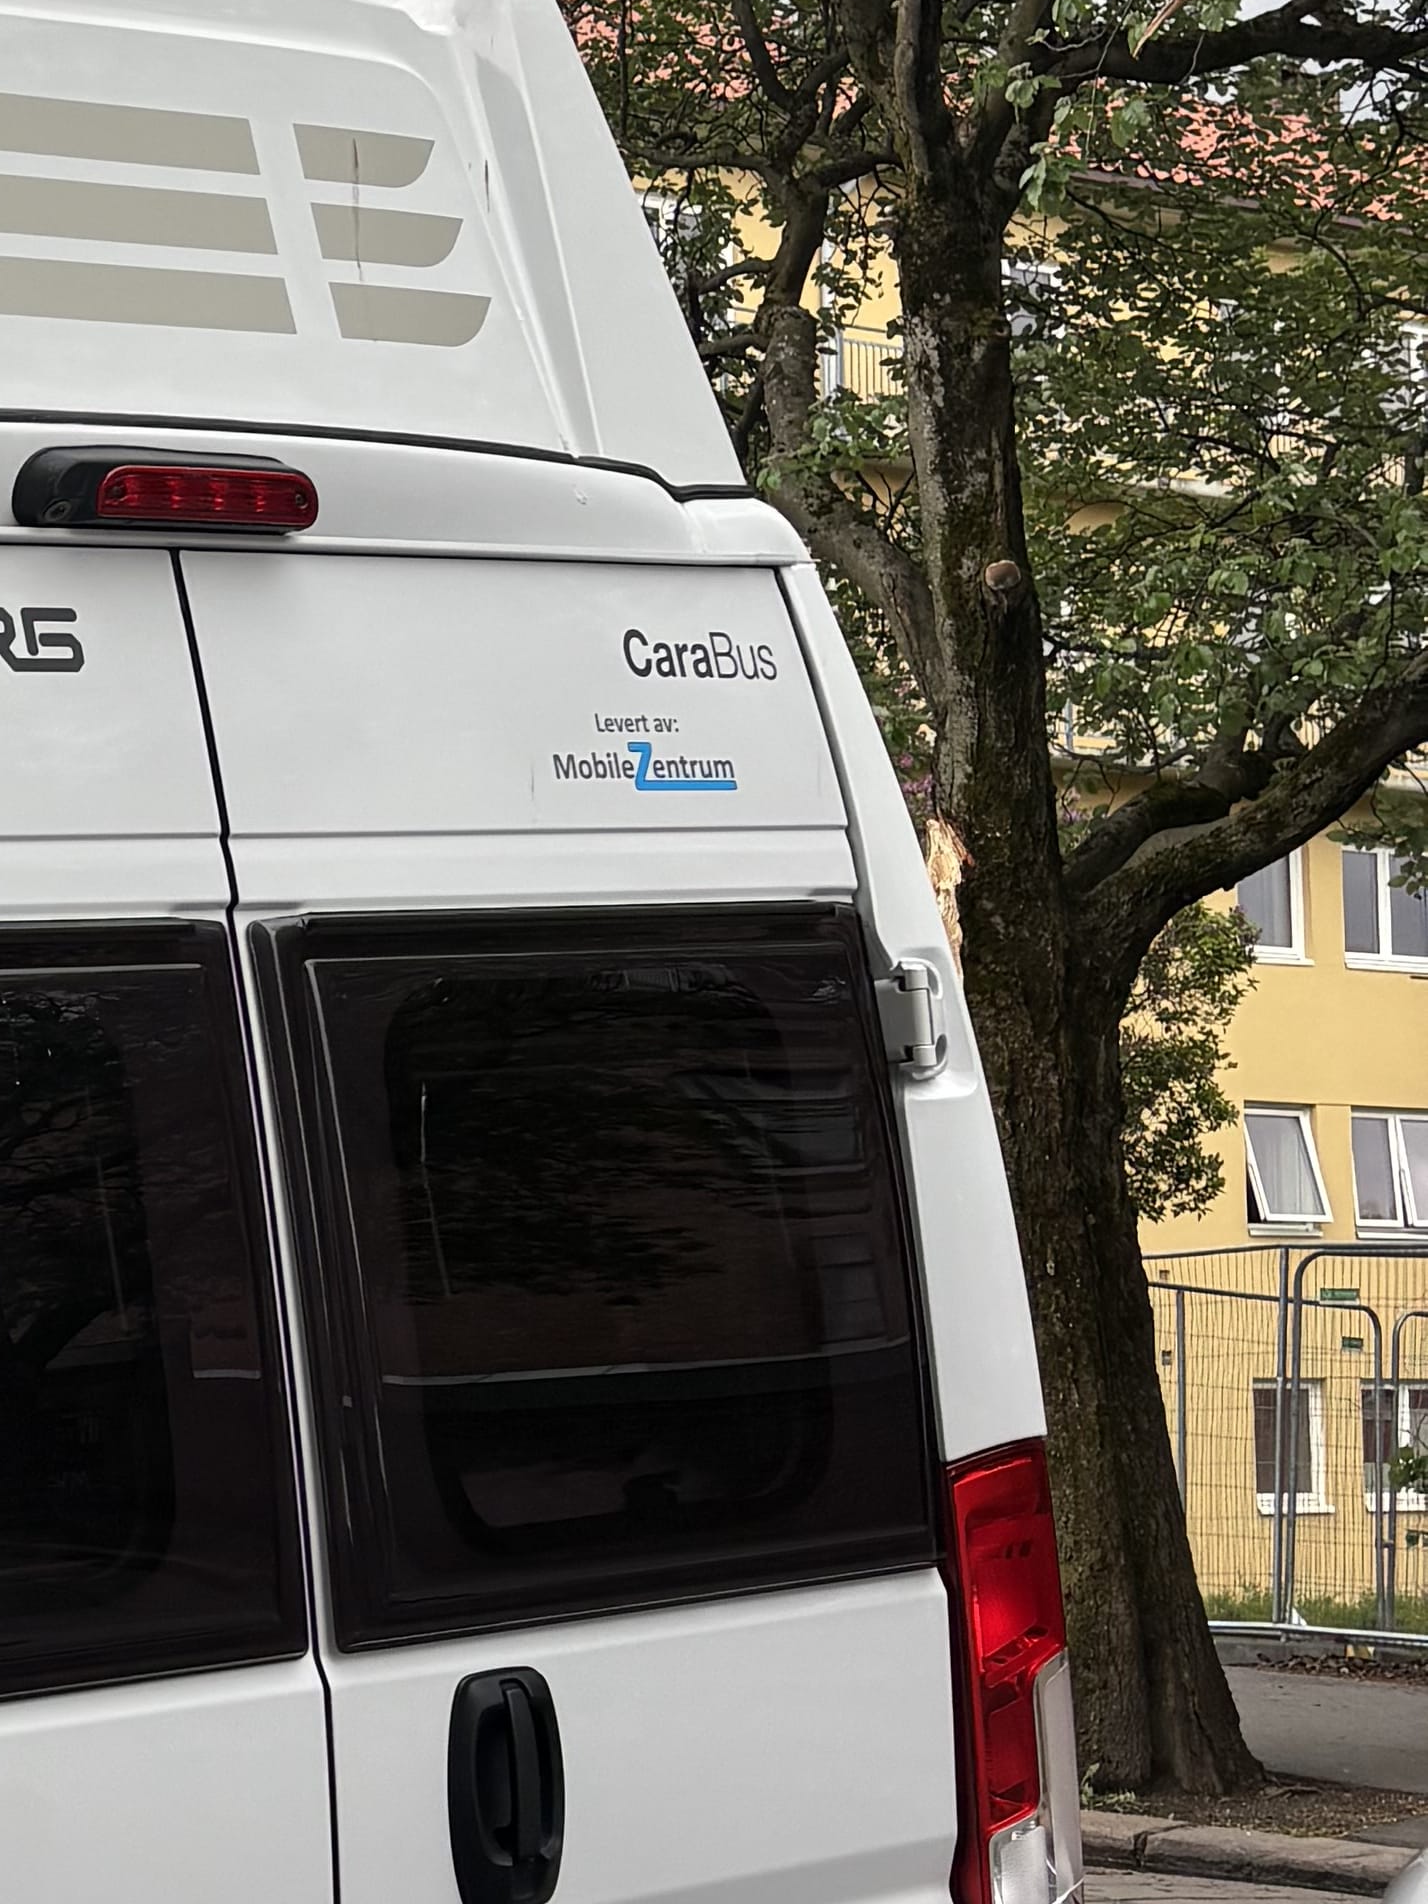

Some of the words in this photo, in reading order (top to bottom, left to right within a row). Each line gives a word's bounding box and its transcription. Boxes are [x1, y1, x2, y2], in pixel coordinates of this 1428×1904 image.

[623, 629, 778, 680] CaraBus
[594, 713, 650, 732] Levert
[653, 718, 679, 732] av:
[553, 742, 737, 790] MobileZentrum
